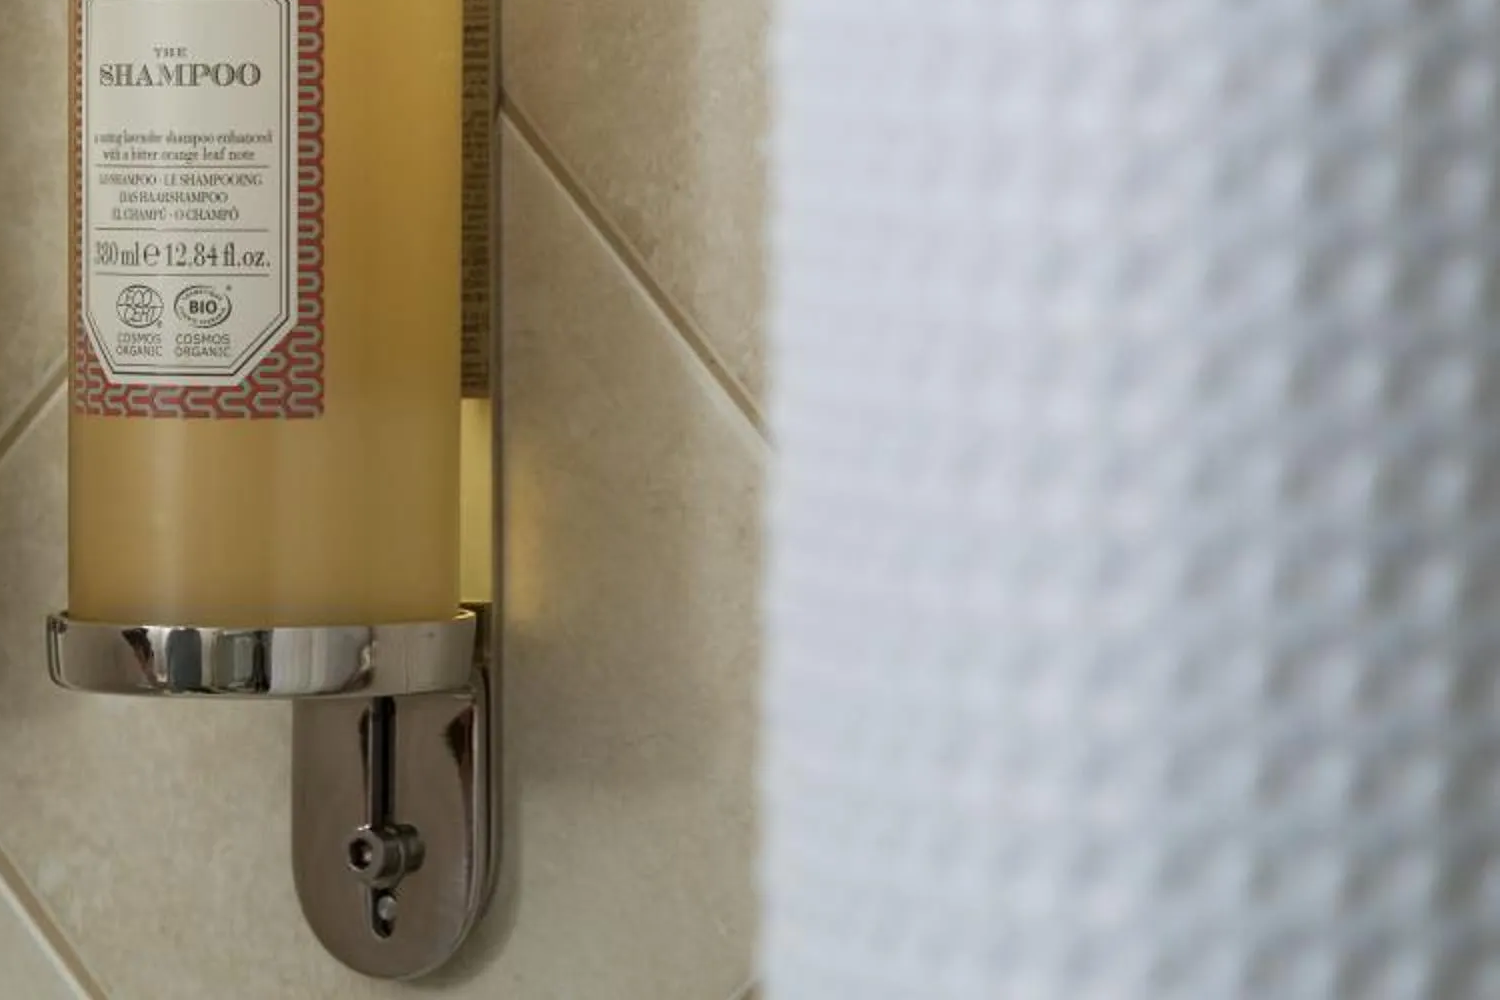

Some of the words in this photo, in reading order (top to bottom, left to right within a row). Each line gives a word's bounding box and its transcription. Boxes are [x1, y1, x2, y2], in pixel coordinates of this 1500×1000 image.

[153, 46, 187, 57] THE
[99, 63, 261, 87] SHAMPOO
[203, 146, 225, 160] leaf
[180, 173, 263, 187] SHAMPOOING
[165, 241, 218, 267] 12.84
[189, 300, 217, 315] BIO
[175, 333, 230, 345] COSMOS
[174, 346, 230, 358] ORGANIC
